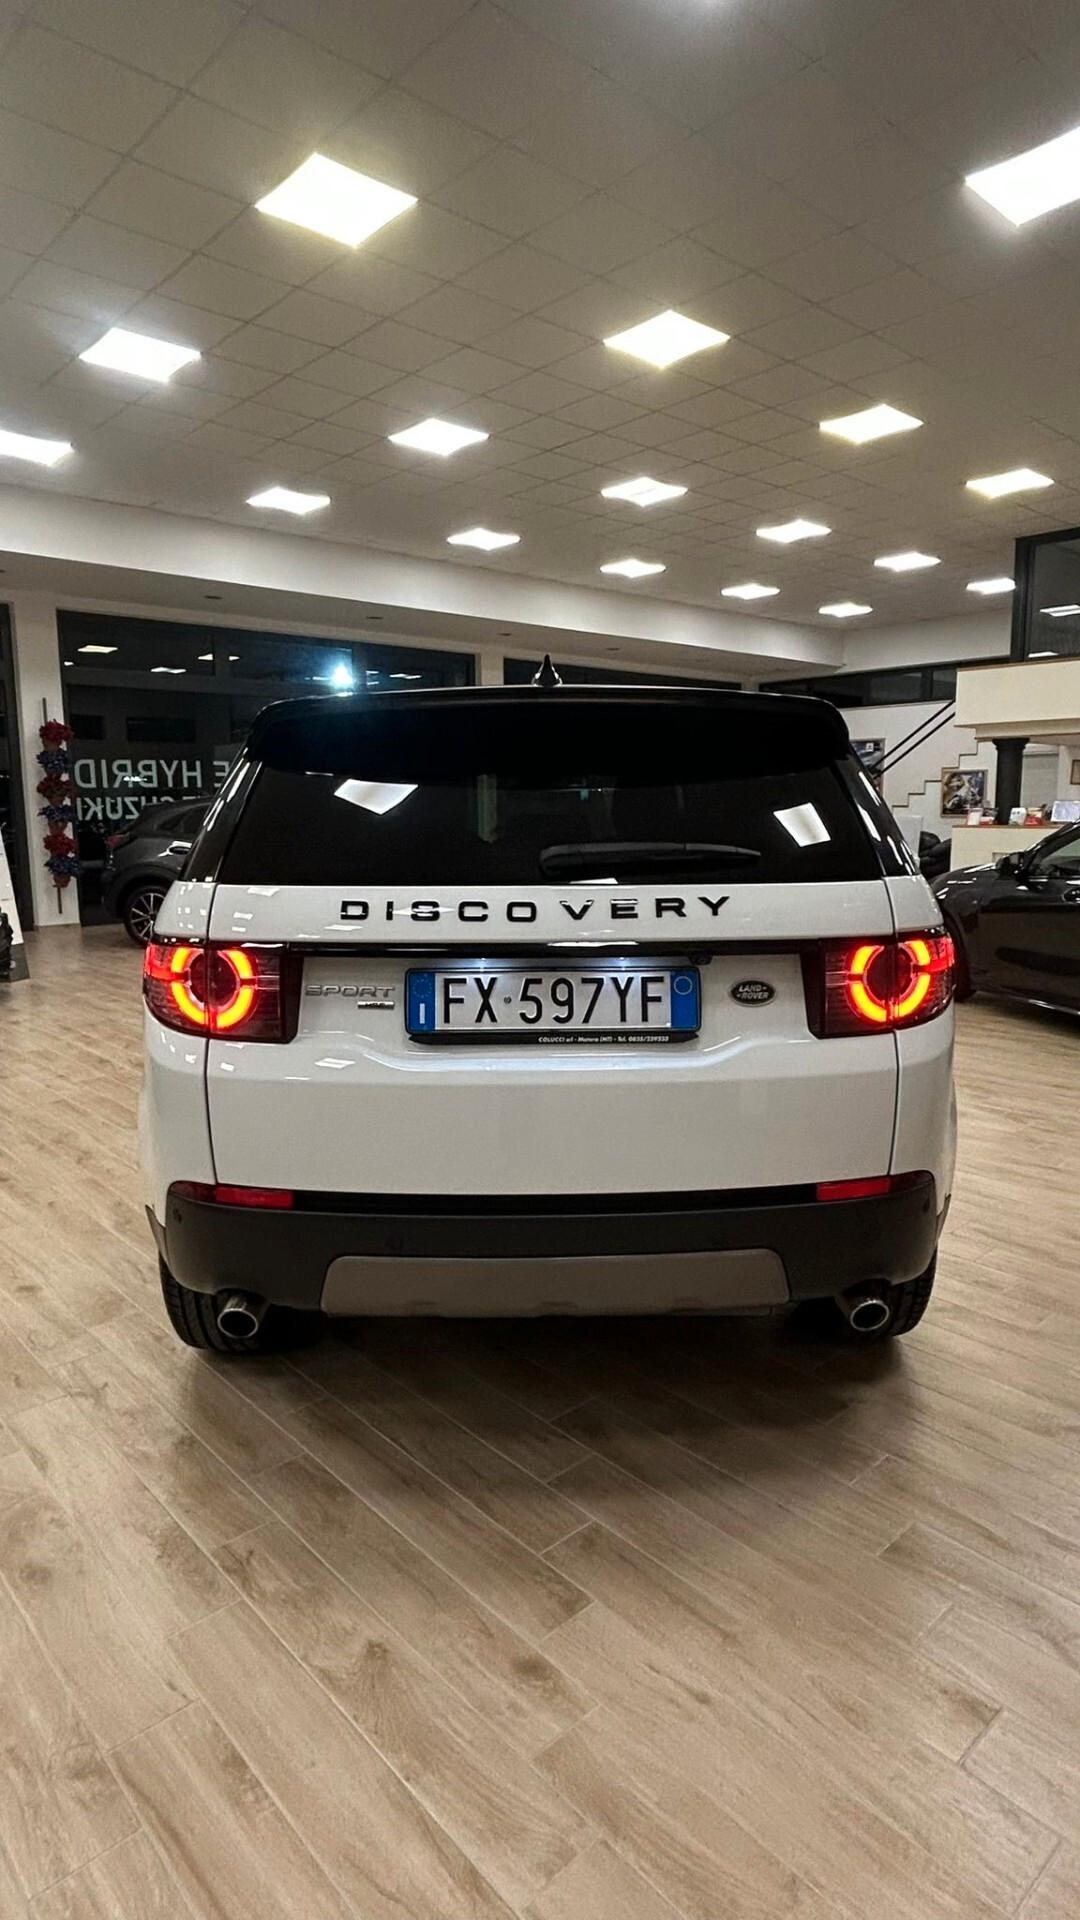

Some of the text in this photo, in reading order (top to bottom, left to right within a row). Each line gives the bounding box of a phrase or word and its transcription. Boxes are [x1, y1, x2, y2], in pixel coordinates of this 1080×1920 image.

[340, 896, 730, 921] DISCOVERY
[305, 985, 395, 997] SPORT
[443, 976, 665, 1024] FX 597YF
